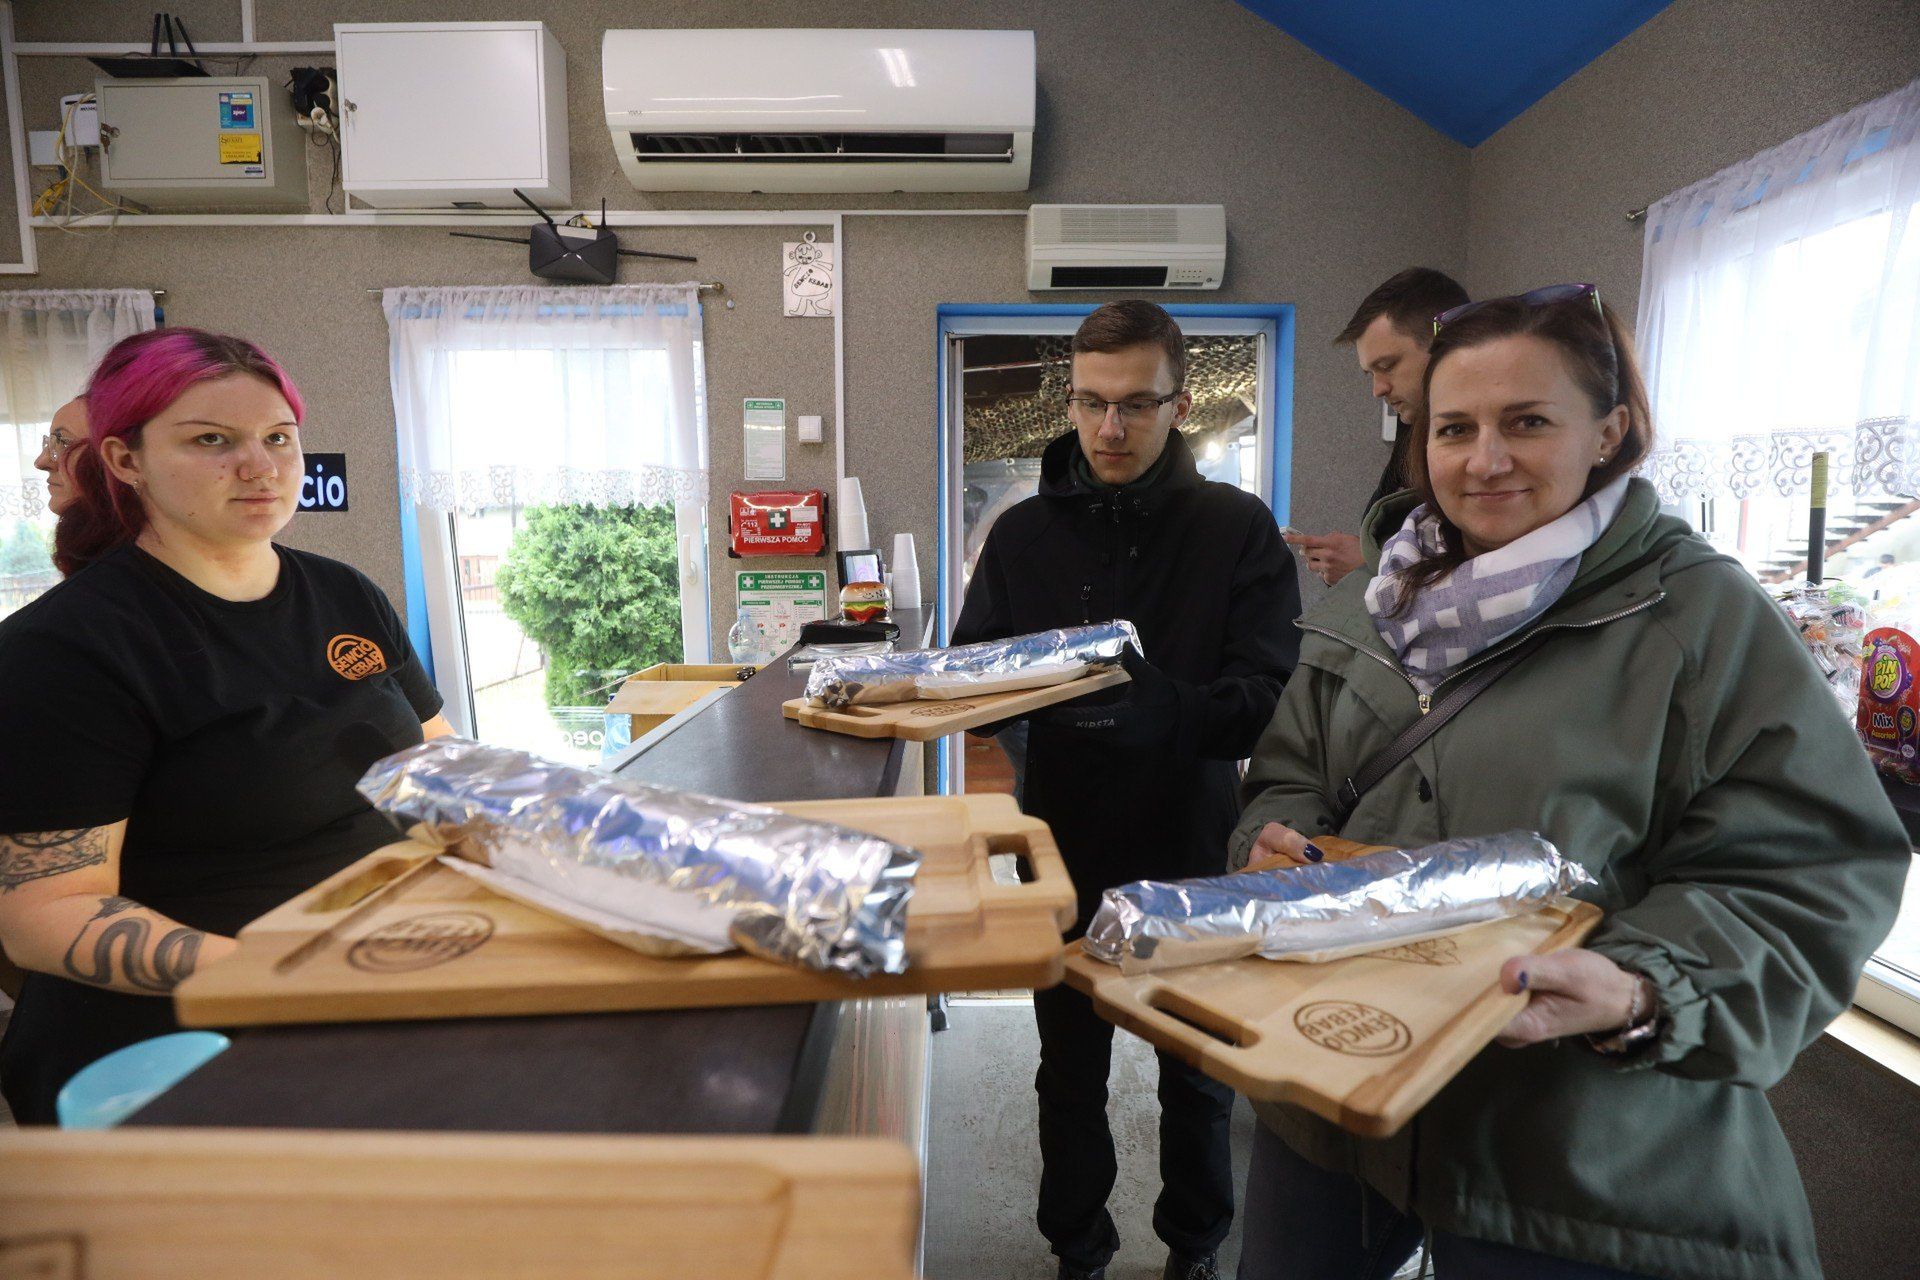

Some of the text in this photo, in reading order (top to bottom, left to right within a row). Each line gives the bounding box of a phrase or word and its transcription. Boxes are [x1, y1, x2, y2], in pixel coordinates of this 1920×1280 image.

[808, 278, 828, 288] KEBAB
[300, 464, 344, 507] cio
[335, 641, 373, 671] SEWCIO
[345, 650, 382, 680] KEBAB
[1873, 673, 1897, 690] POP
[1872, 712, 1895, 729] Mix
[1871, 729, 1896, 739] Assorted
